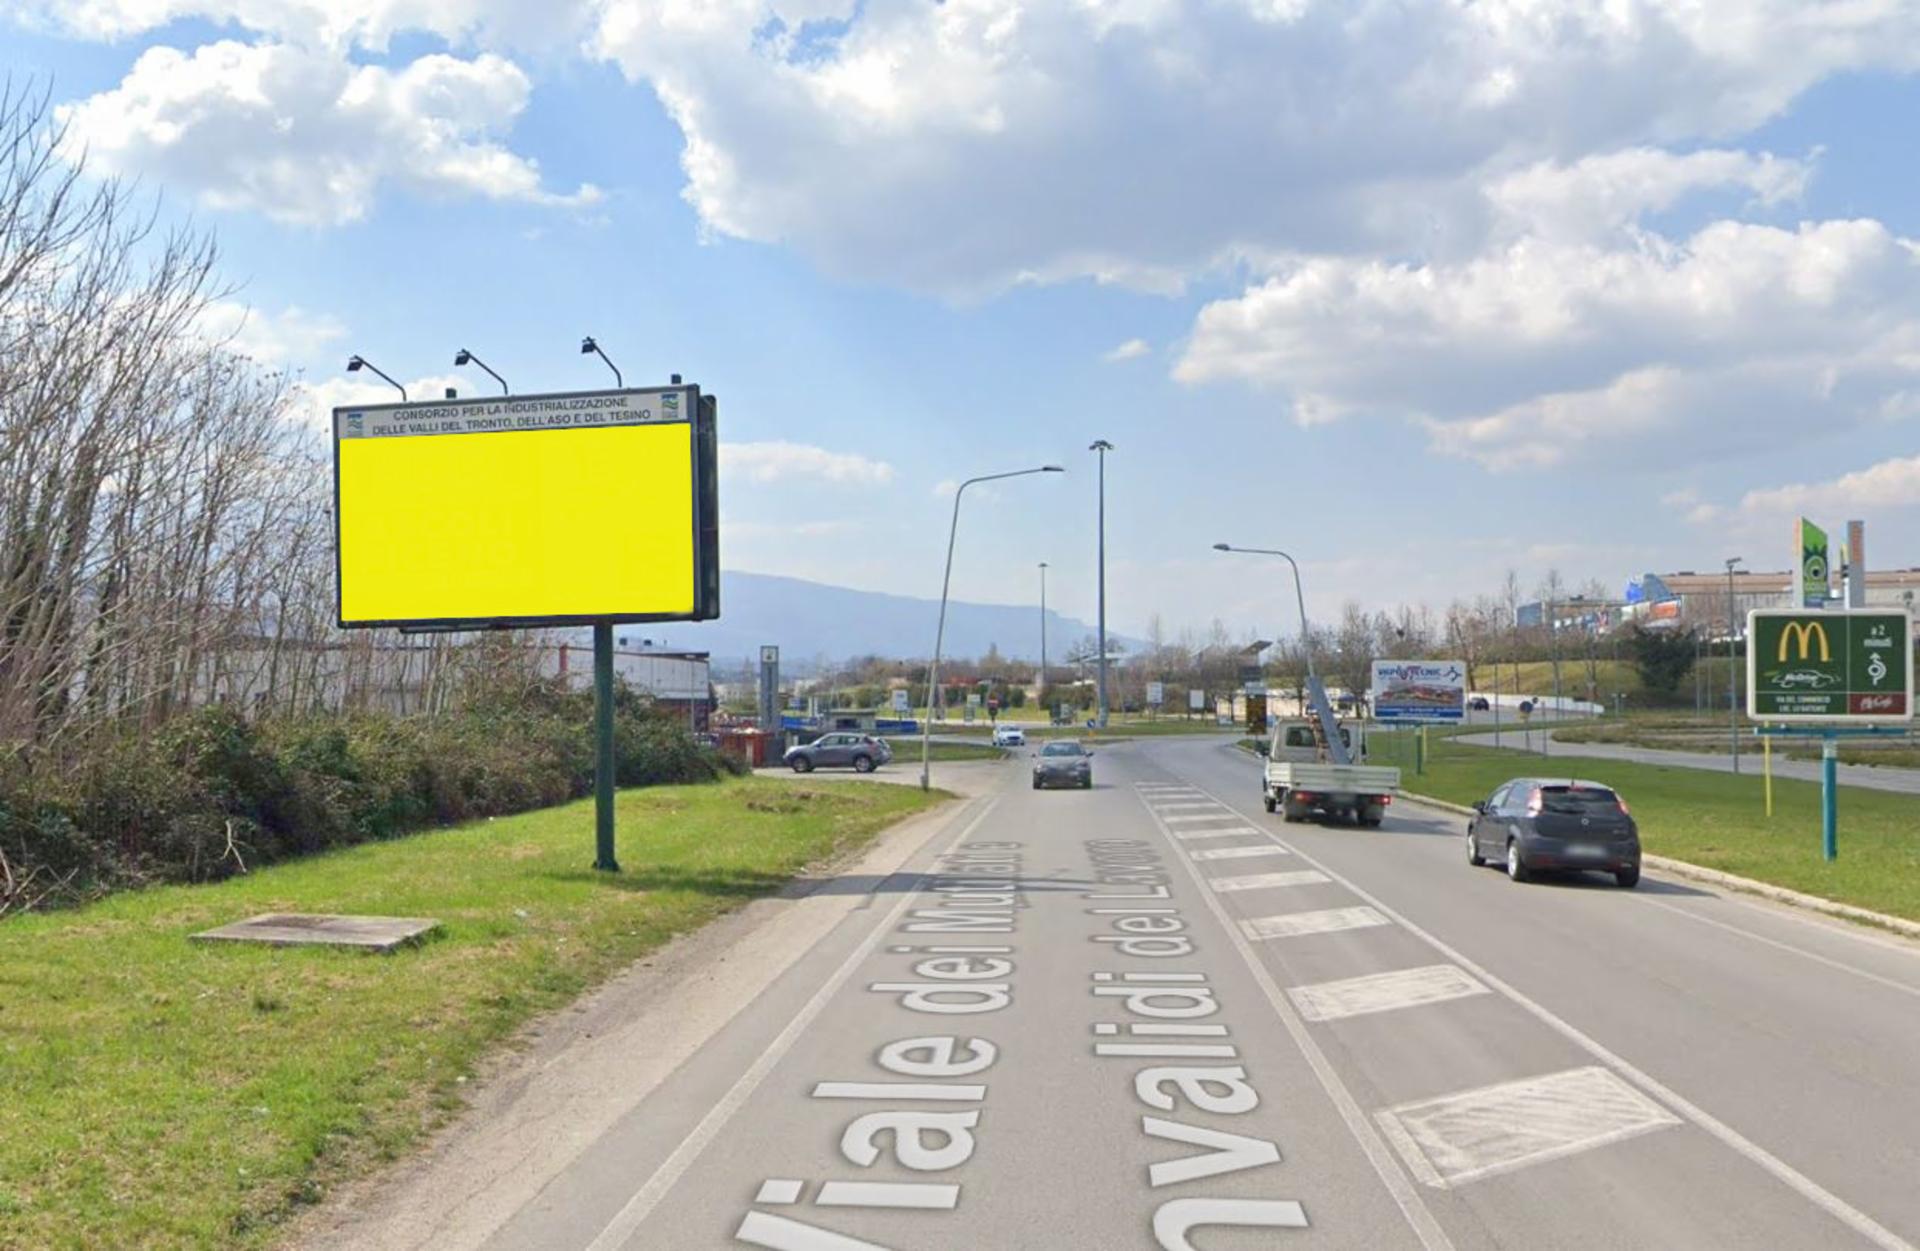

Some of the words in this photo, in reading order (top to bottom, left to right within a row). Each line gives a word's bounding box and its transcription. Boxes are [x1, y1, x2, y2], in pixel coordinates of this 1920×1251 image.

[394, 407, 458, 420] CONSORZIO
[462, 406, 485, 416] PER
[487, 405, 501, 415] LA
[504, 397, 628, 414] INDUSTRIALIZZAZIONE
[373, 424, 406, 435] DELLE
[409, 422, 439, 433] VALLI
[441, 421, 461, 431] DEL
[574, 413, 582, 423] E
[585, 412, 605, 422] DEL
[610, 409, 650, 421] TESINO
